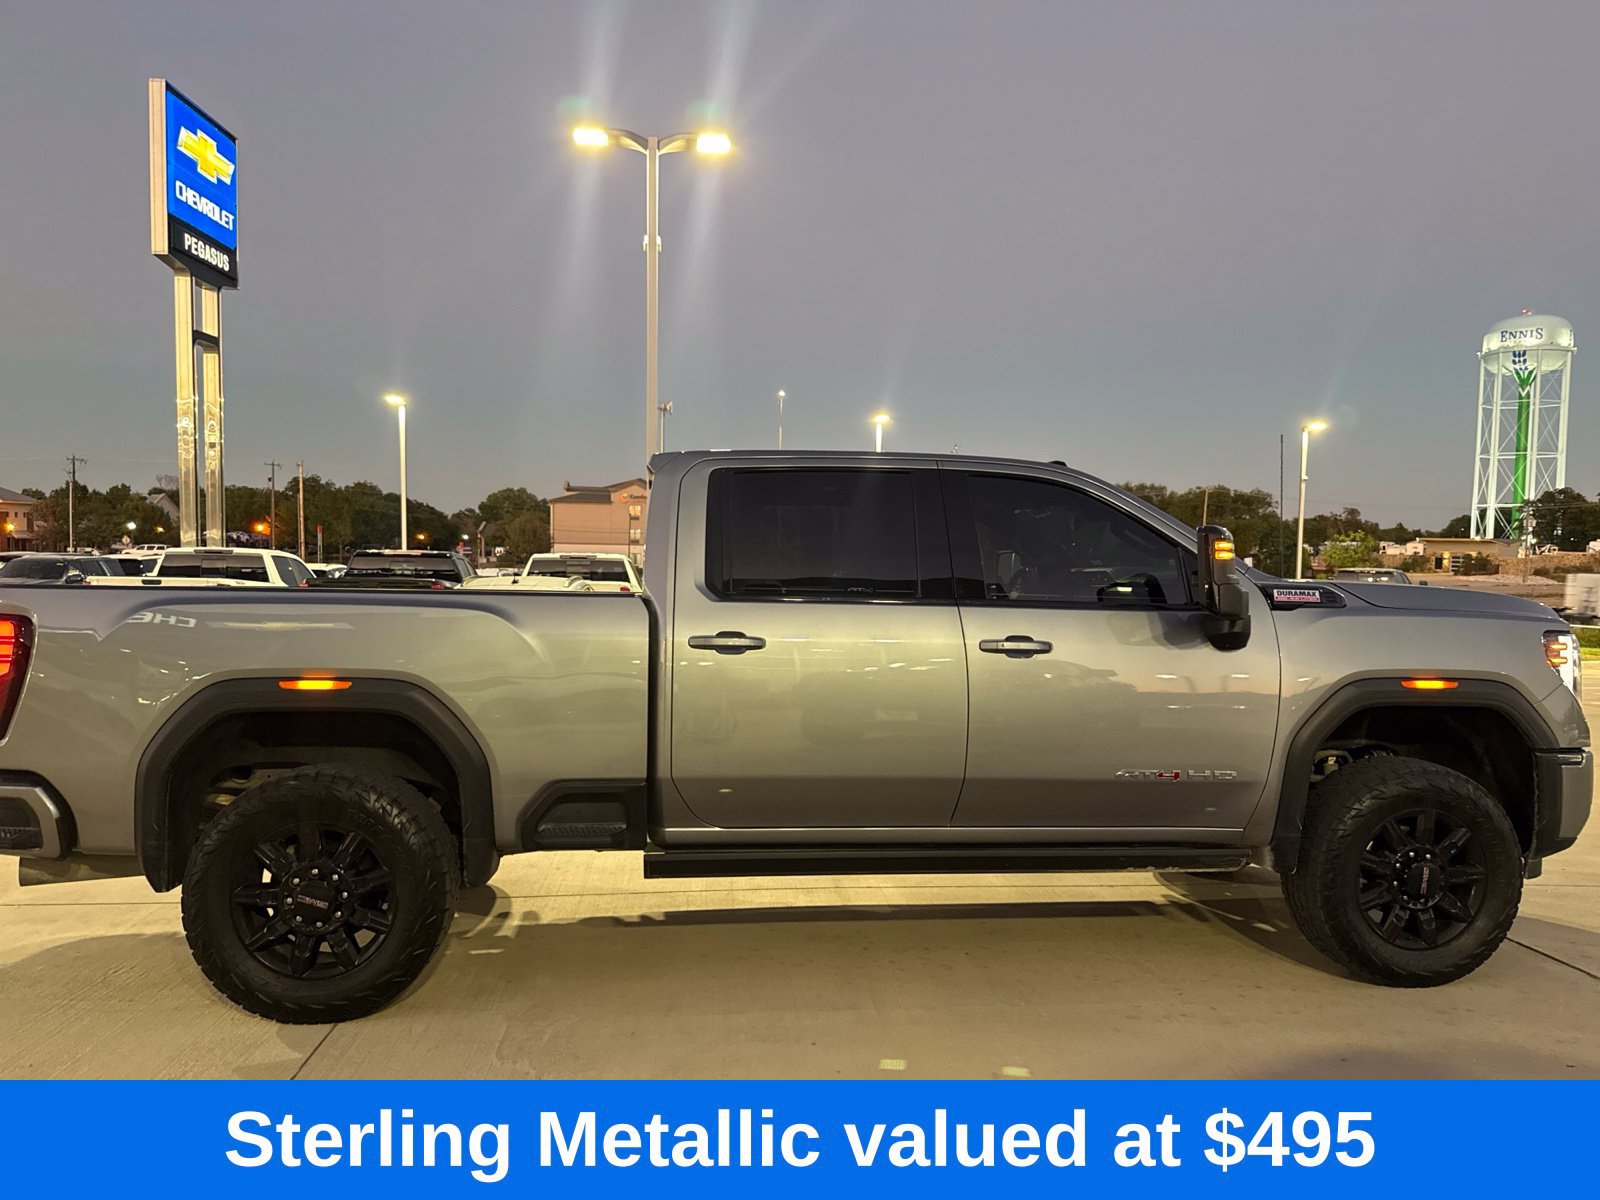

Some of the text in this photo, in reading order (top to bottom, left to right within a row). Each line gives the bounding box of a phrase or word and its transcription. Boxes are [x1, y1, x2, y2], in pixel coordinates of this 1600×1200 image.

[175, 180, 235, 231] CHEVROLET
[184, 232, 230, 272] PEGASUS
[1500, 327, 1544, 343] ENNIS
[1276, 590, 1317, 598] DURAMAX
[1187, 769, 1238, 781] HD
